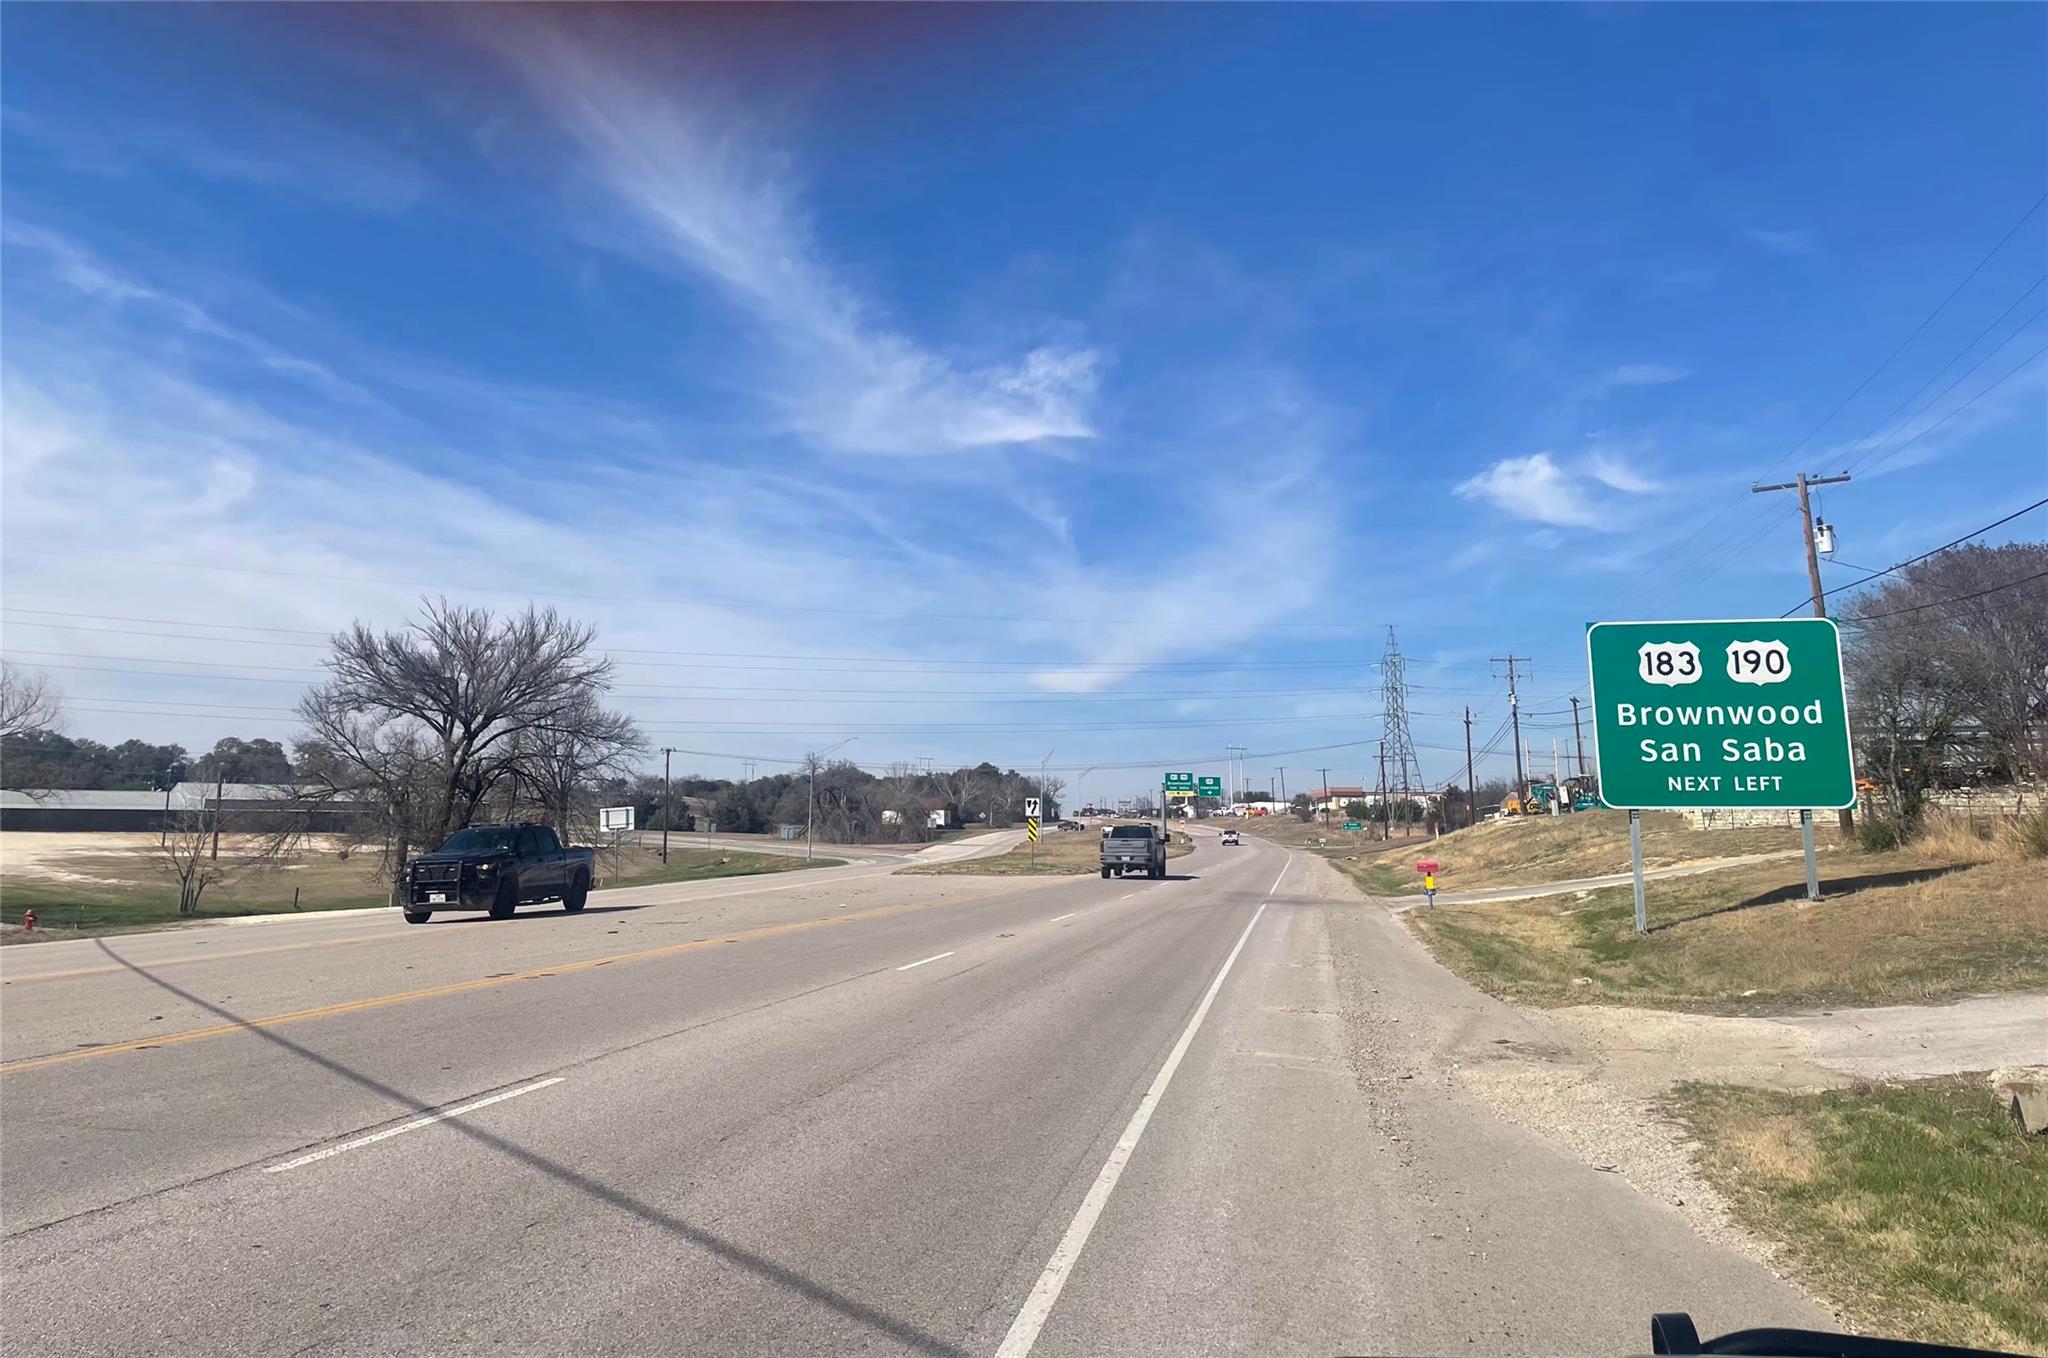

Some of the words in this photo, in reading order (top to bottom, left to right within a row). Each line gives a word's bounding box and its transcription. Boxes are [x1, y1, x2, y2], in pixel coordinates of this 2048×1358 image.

[1644, 651, 1696, 676] 183
[1731, 649, 1785, 675] 190
[1616, 699, 1823, 726] Brownwood
[1640, 738, 1702, 762] San
[1722, 736, 1807, 762] Saba
[1667, 776, 1722, 791] NEXT
[1733, 775, 1783, 791] LEFT
